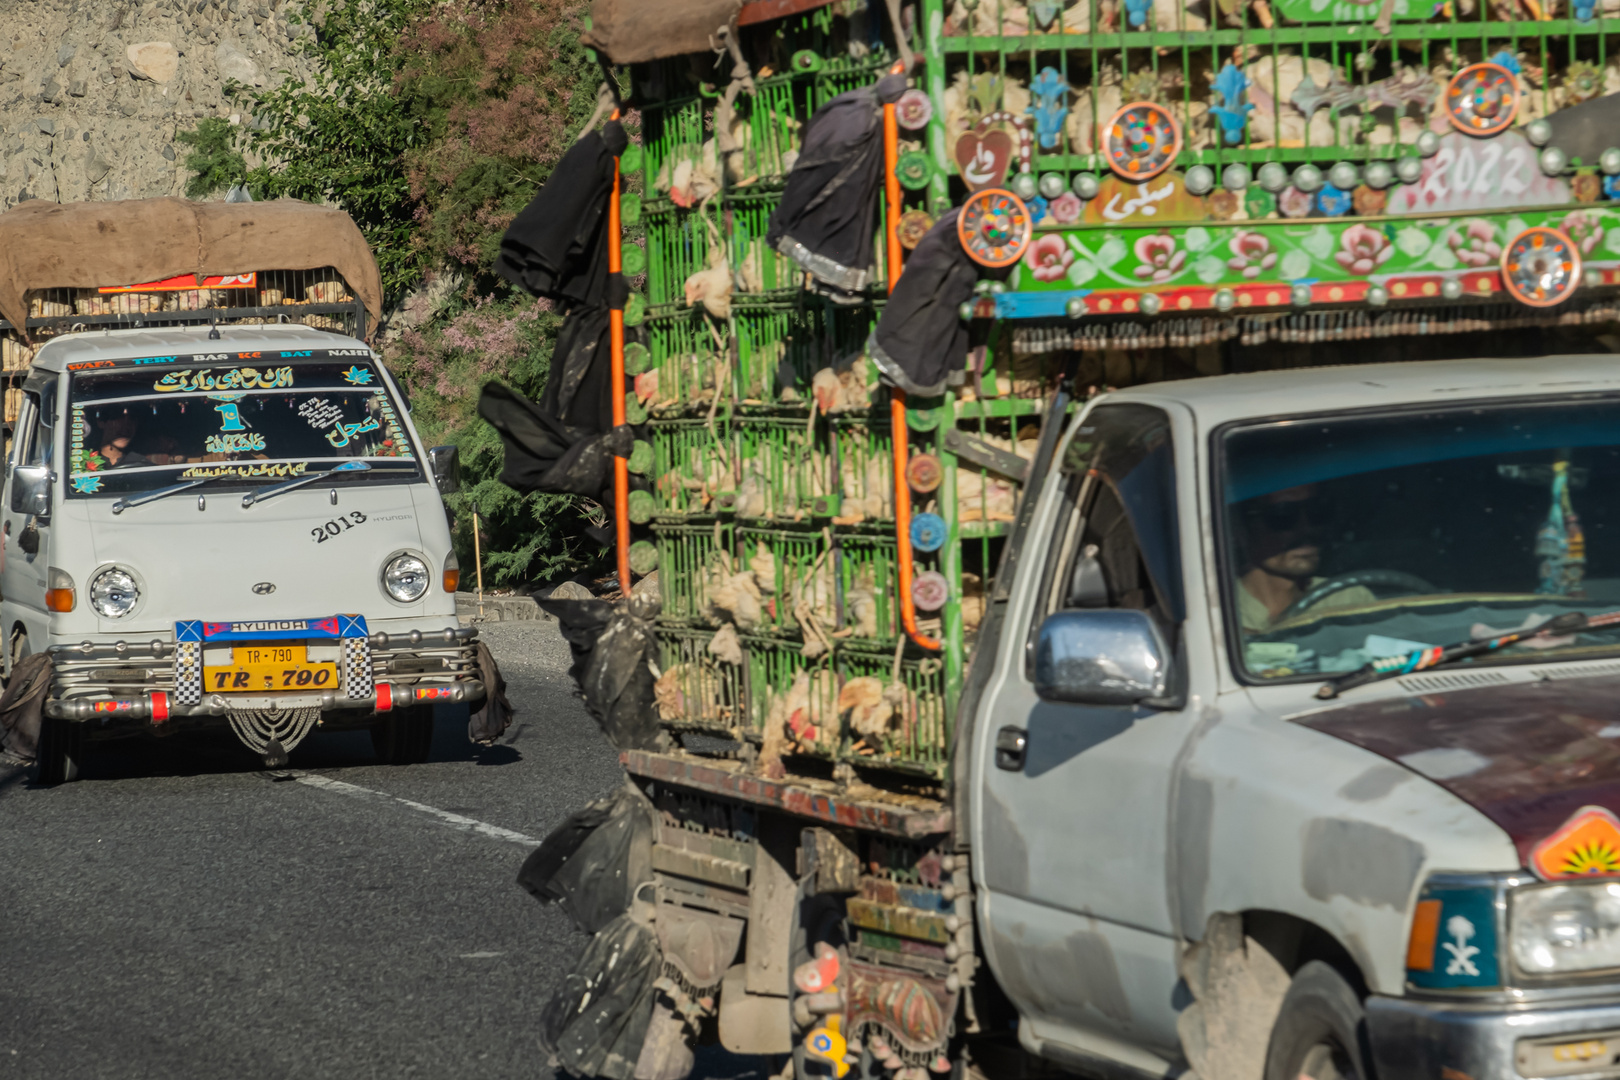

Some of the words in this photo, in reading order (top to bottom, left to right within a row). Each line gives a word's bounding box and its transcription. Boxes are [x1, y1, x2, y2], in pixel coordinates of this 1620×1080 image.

[1424, 142, 1531, 198] 2022
[132, 356, 178, 365] TERY
[192, 353, 229, 362] BAS
[280, 350, 313, 358] BAT
[327, 349, 369, 357] NAHI
[213, 403, 246, 431] 1
[311, 510, 368, 544] 2013
[231, 620, 309, 632] HYUNDAI
[247, 650, 261, 663] TR
[272, 648, 292, 663] 790
[214, 671, 251, 689] TR
[282, 668, 330, 687] 790
